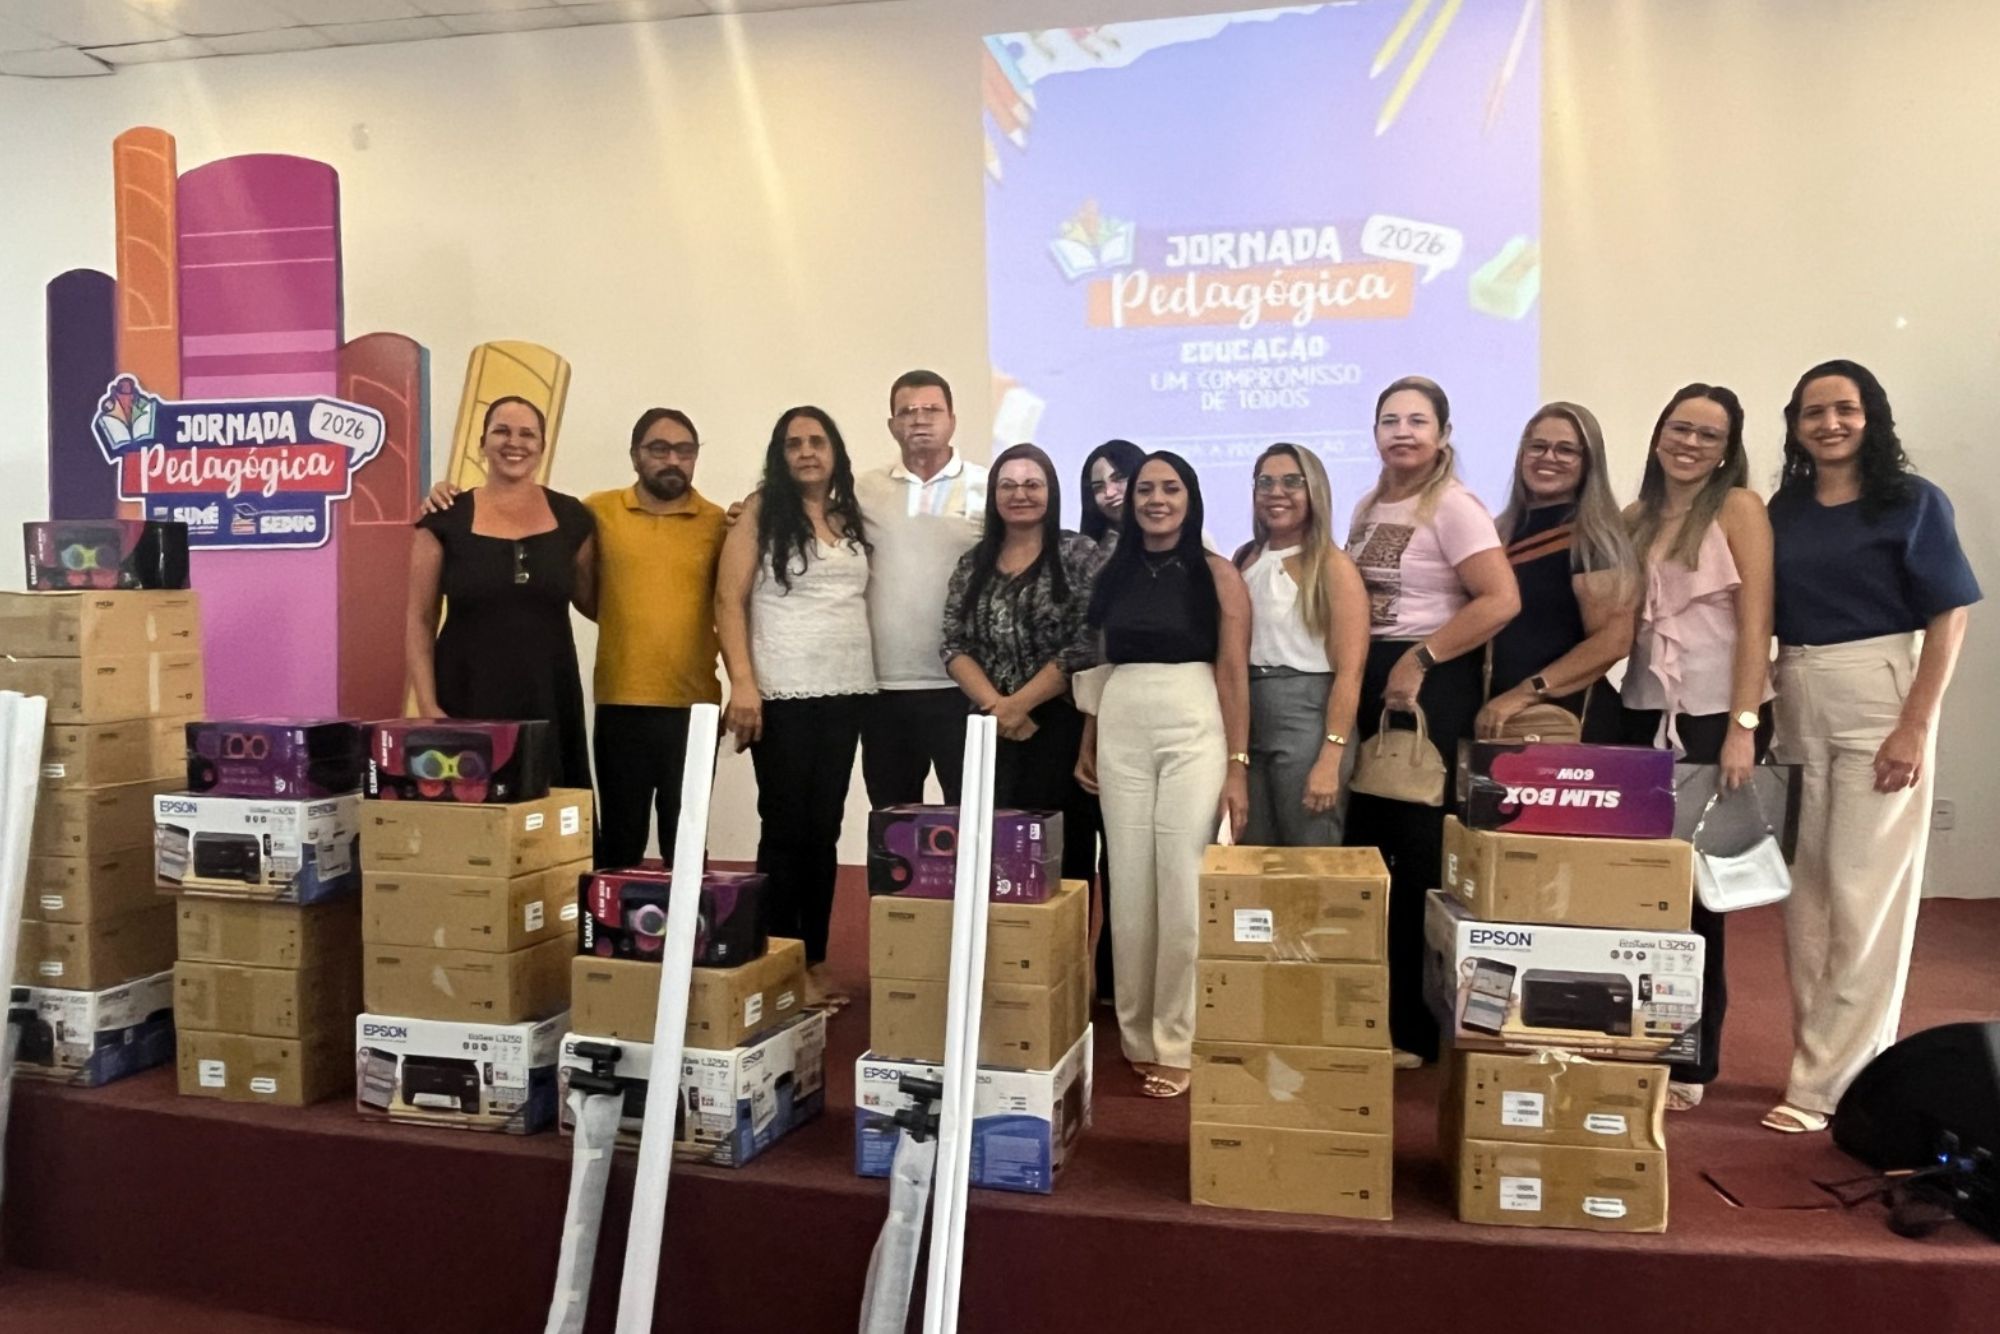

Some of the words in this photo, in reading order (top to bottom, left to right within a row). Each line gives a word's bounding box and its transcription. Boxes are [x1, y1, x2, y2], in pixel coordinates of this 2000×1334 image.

[1166, 226, 1342, 268] JORNADA
[1377, 223, 1444, 255] 2026
[1111, 269, 1396, 329] Pedagógica
[1180, 335, 1325, 364] EDUCAÇÃO
[1151, 370, 1188, 392] UM
[1197, 363, 1361, 391] COMPROMISSO
[1201, 390, 1226, 411] DE
[1239, 387, 1309, 409] TODOS
[176, 411, 297, 446] JORNADA
[319, 411, 366, 440] 2026
[140, 443, 336, 497] Pedagógica
[173, 502, 219, 525] SUMÉ
[259, 514, 317, 535] SEDUC
[1556, 768, 1595, 781] 60W
[159, 800, 198, 814] EPSON
[1502, 786, 1557, 807] BOX
[1559, 789, 1622, 808] SLIM
[584, 911, 593, 949] SUMAY
[1469, 929, 1532, 946] EPSON
[1658, 939, 1696, 951] L3250
[363, 1023, 408, 1038] EPSON
